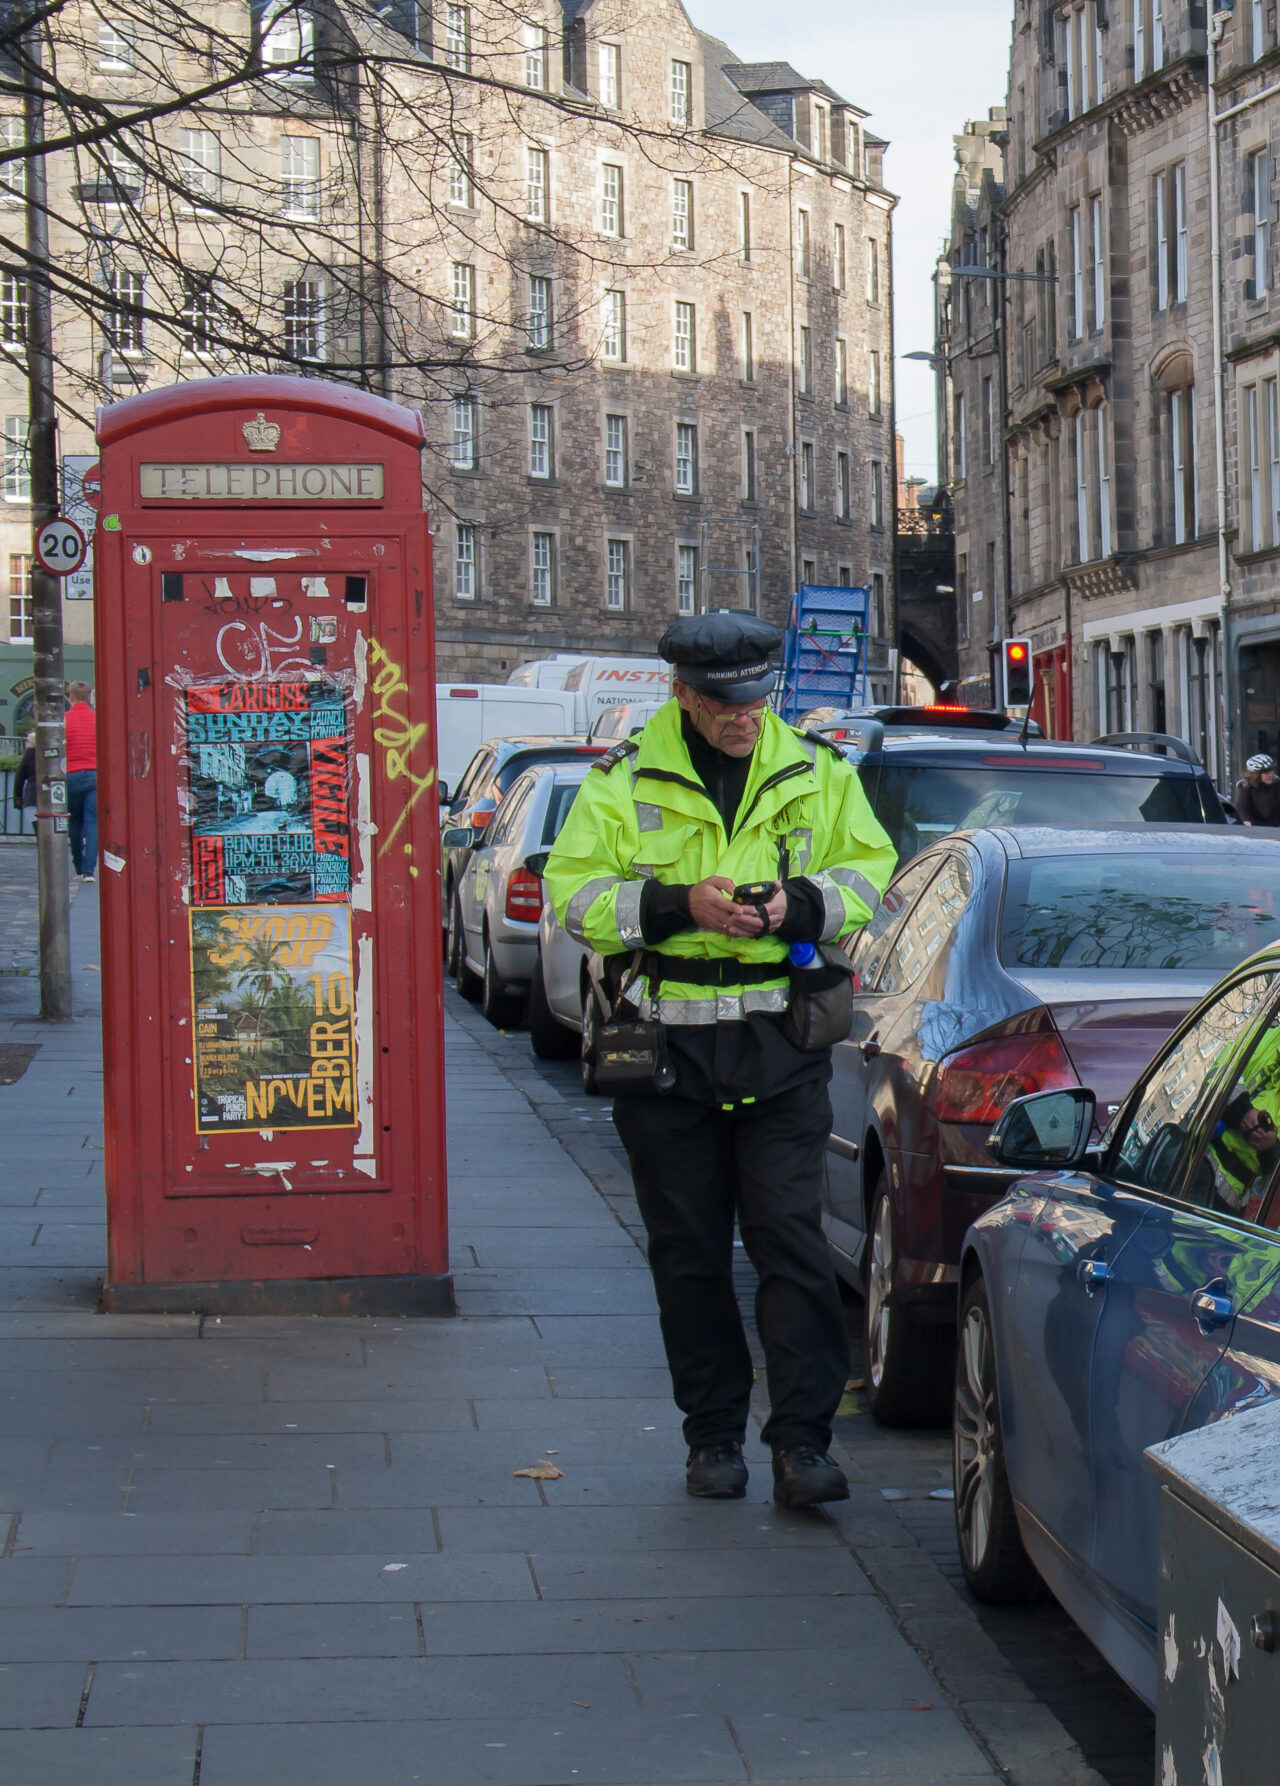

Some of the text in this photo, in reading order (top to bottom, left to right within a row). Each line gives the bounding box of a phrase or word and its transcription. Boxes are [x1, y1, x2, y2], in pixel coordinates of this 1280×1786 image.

[152, 468, 376, 496] TELEPHONE
[43, 534, 78, 558] 20
[71, 576, 91, 585] Use
[707, 671, 738, 680] PARKING
[188, 711, 310, 729] SUNDAY
[310, 710, 345, 726] LAUNCH
[188, 724, 311, 743] SERIES
[224, 834, 315, 854] BONGO CLUB
[258, 853, 279, 867] TIL
[281, 852, 315, 868] 3AM
[225, 866, 279, 875] TICKETS
[315, 872, 350, 884] FRIENDS
[308, 972, 347, 1016] 10
[310, 1020, 350, 1078] BER
[217, 1095, 246, 1105] TROPICAL
[246, 1077, 352, 1120] NOVEM
[225, 1103, 247, 1112] PUNCH
[223, 1111, 241, 1121] PARTY
[242, 1111, 247, 1120] 2
